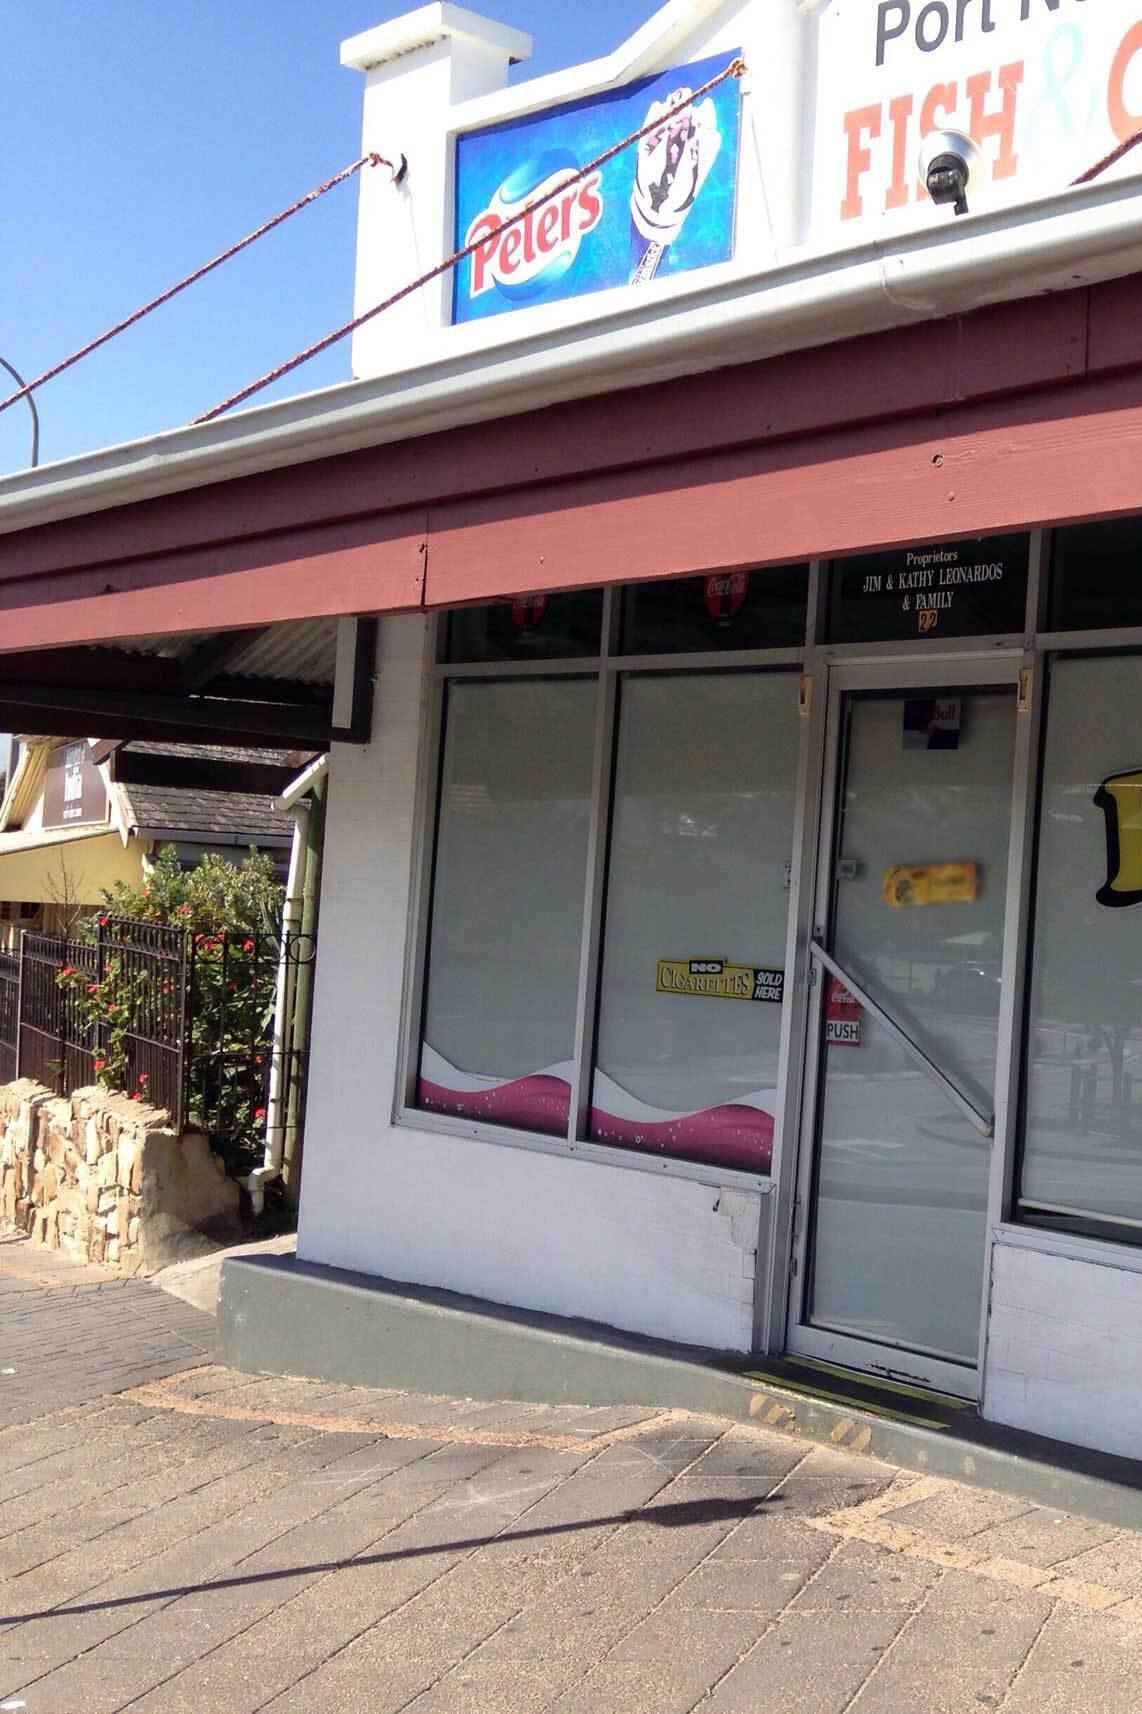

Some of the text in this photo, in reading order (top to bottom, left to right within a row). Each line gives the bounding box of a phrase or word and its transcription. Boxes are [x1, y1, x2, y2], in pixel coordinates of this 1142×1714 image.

[875, 0, 996, 67] Port
[468, 176, 601, 293] Peters
[906, 550, 958, 568] Proprietors
[863, 562, 1004, 592] JIM & KATHY LEONARDOS
[902, 591, 954, 611] & FAMILY
[920, 612, 937, 631] 22
[690, 962, 722, 973] NO
[755, 971, 783, 986] SOLD
[754, 986, 782, 1000] HERE
[827, 1023, 859, 1040] PUSH
